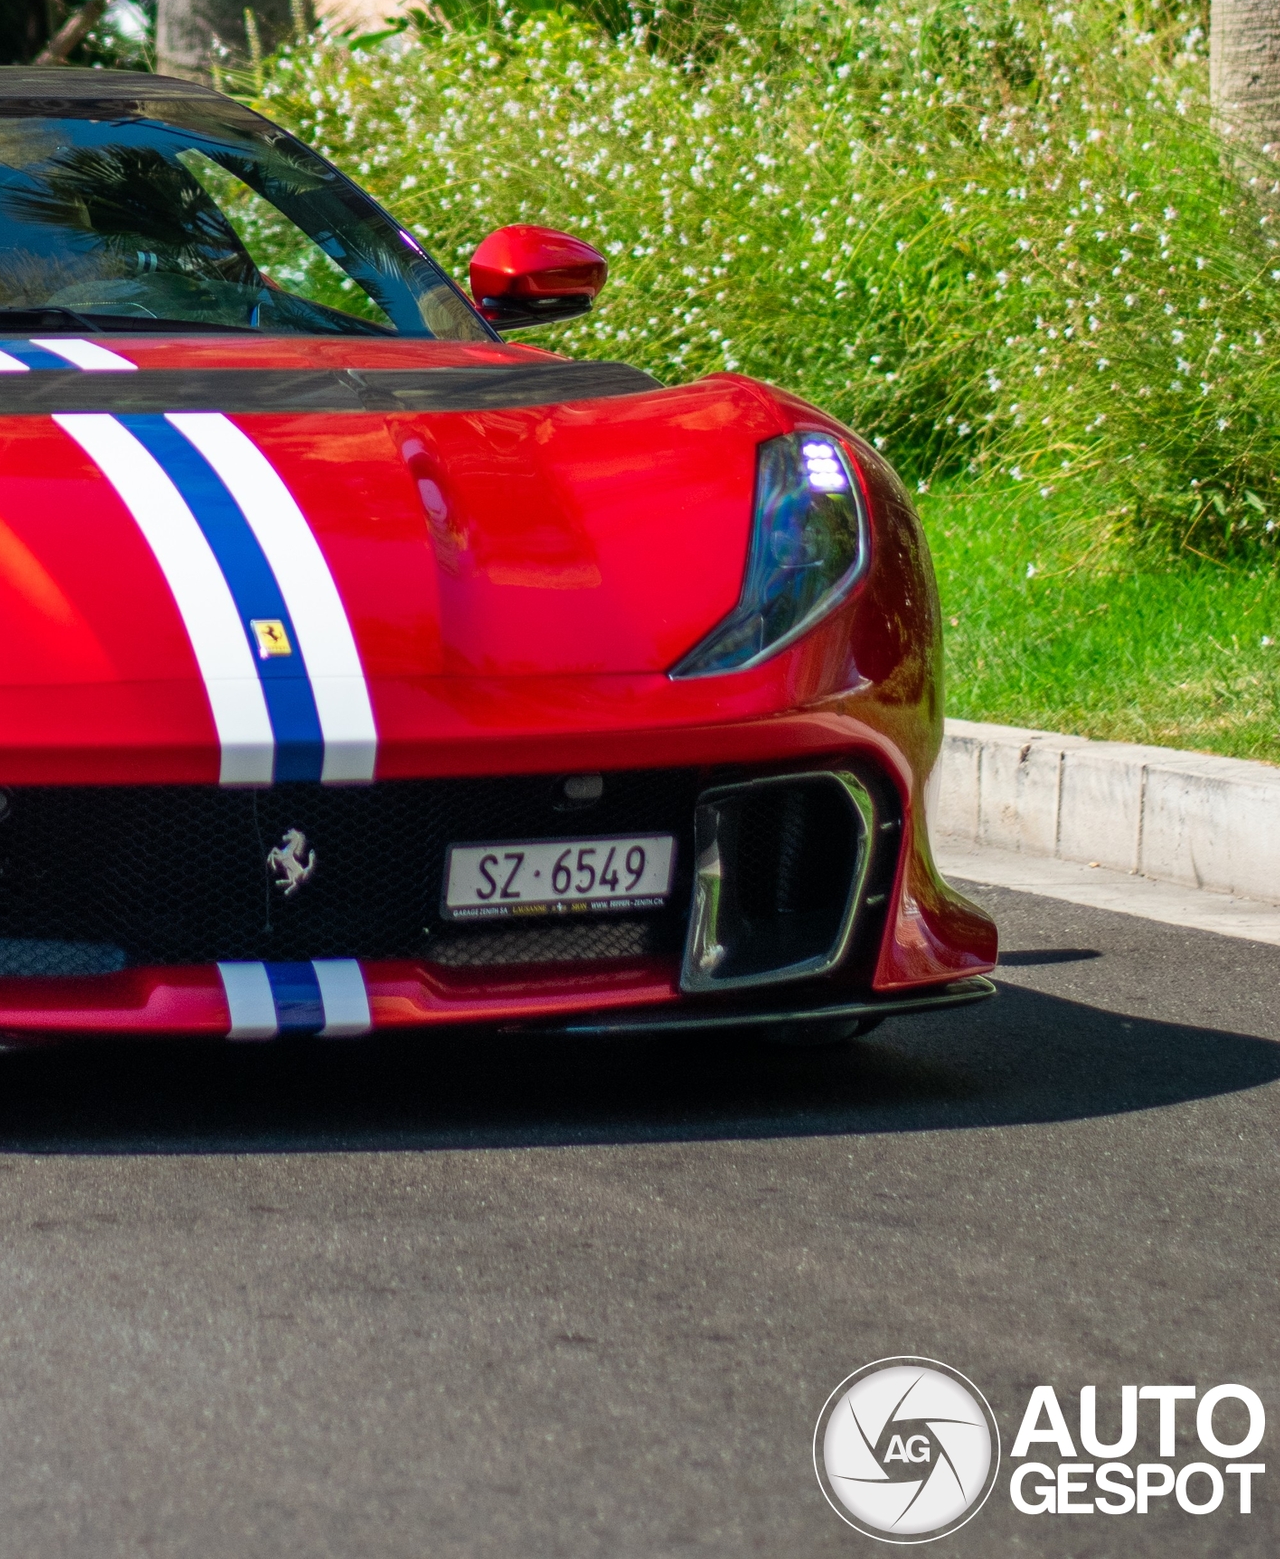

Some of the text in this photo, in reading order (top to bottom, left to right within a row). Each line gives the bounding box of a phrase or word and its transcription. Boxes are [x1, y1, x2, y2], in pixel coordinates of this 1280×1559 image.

[453, 908, 479, 918] GARAGE
[479, 907, 499, 916] ZENITH
[500, 906, 508, 915] SA
